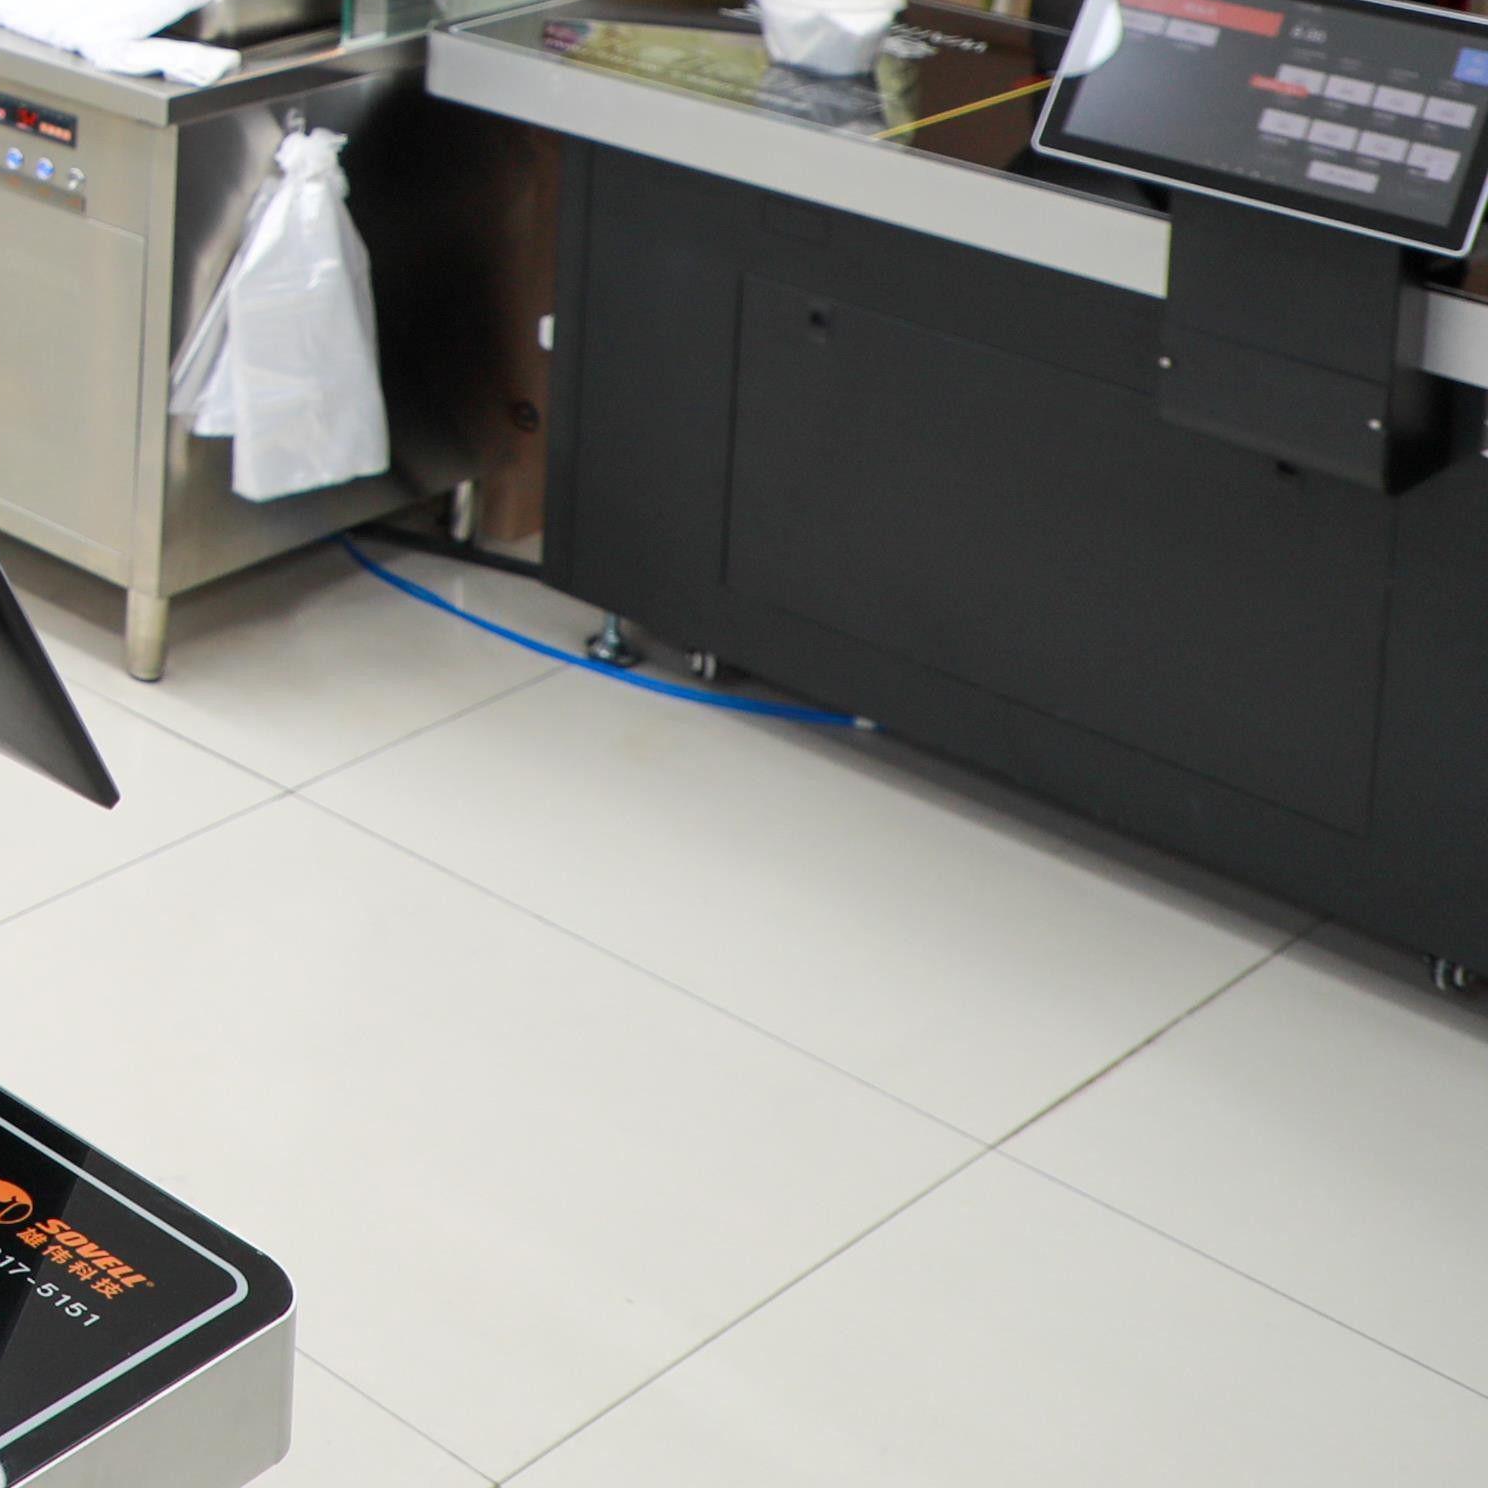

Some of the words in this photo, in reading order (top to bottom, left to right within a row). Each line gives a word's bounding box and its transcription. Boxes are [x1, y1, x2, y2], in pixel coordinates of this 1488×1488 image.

[16, 1225, 124, 1300] 雄伟科技
[35, 1218, 147, 1288] SOVELL
